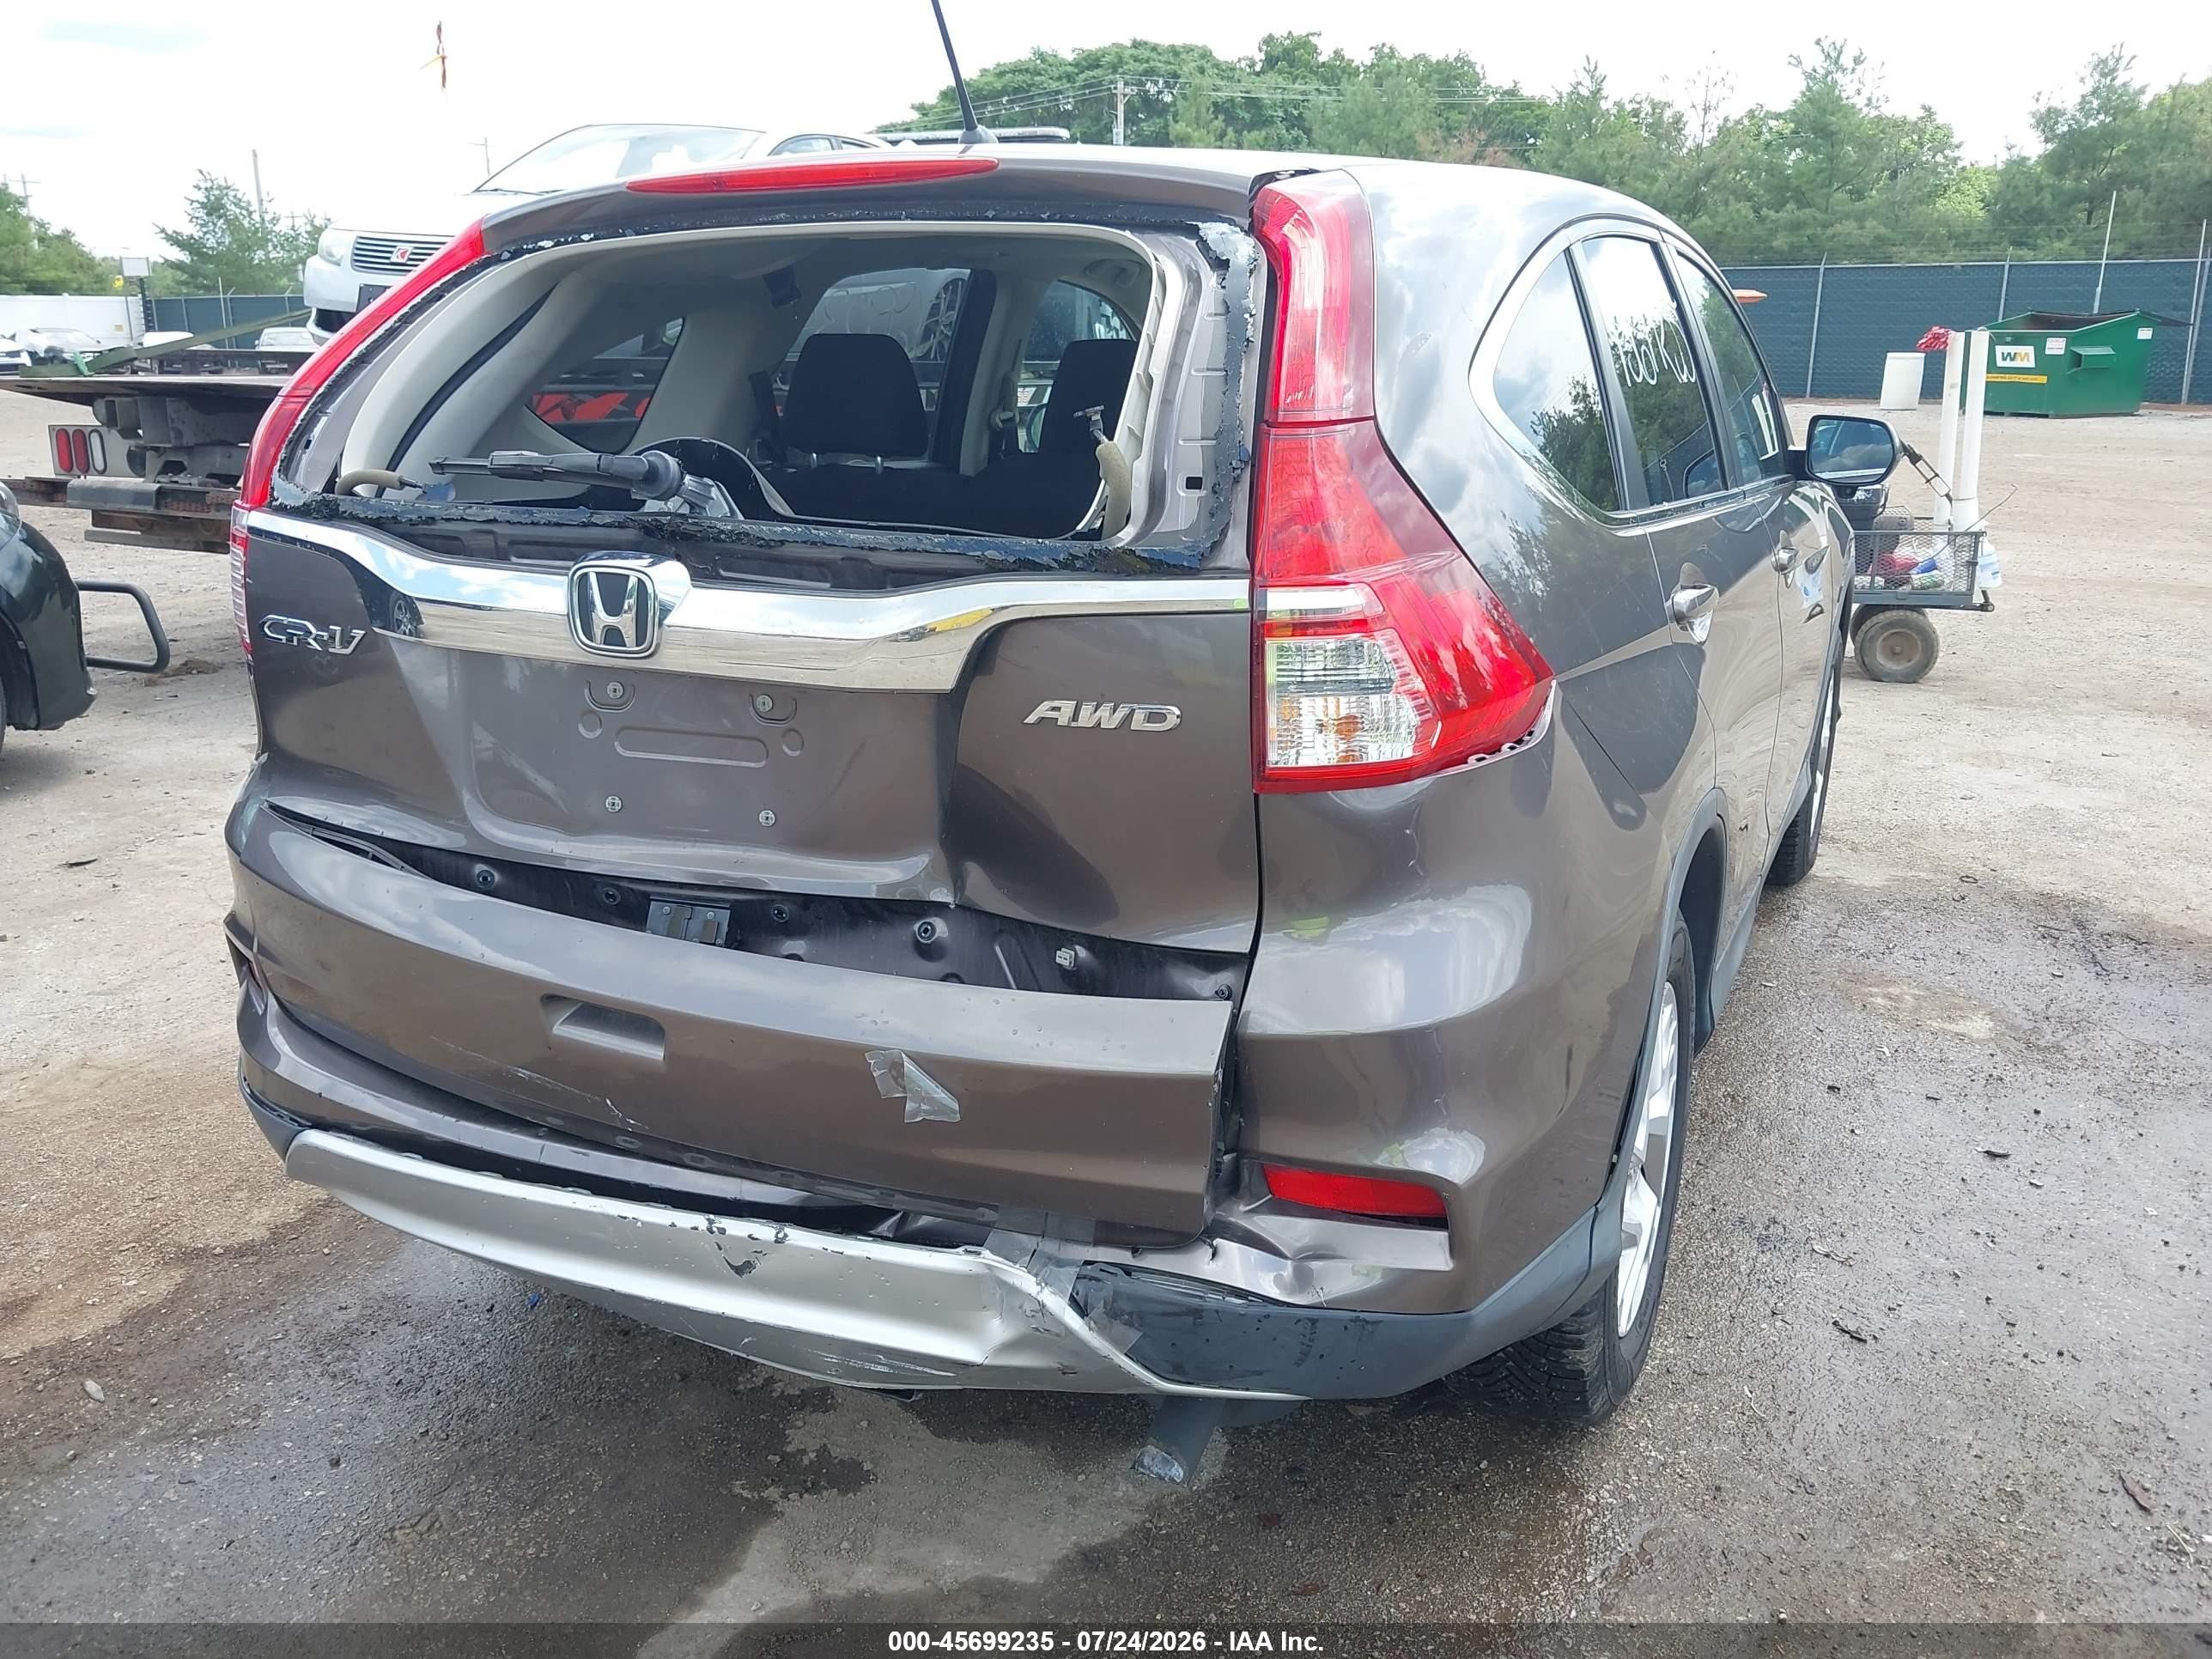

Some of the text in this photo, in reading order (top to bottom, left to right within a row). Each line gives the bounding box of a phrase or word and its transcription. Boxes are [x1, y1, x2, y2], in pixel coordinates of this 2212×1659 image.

[2001, 351, 2030, 362] WM
[258, 614, 367, 655] CR-V
[1023, 699, 1182, 732] AWD
